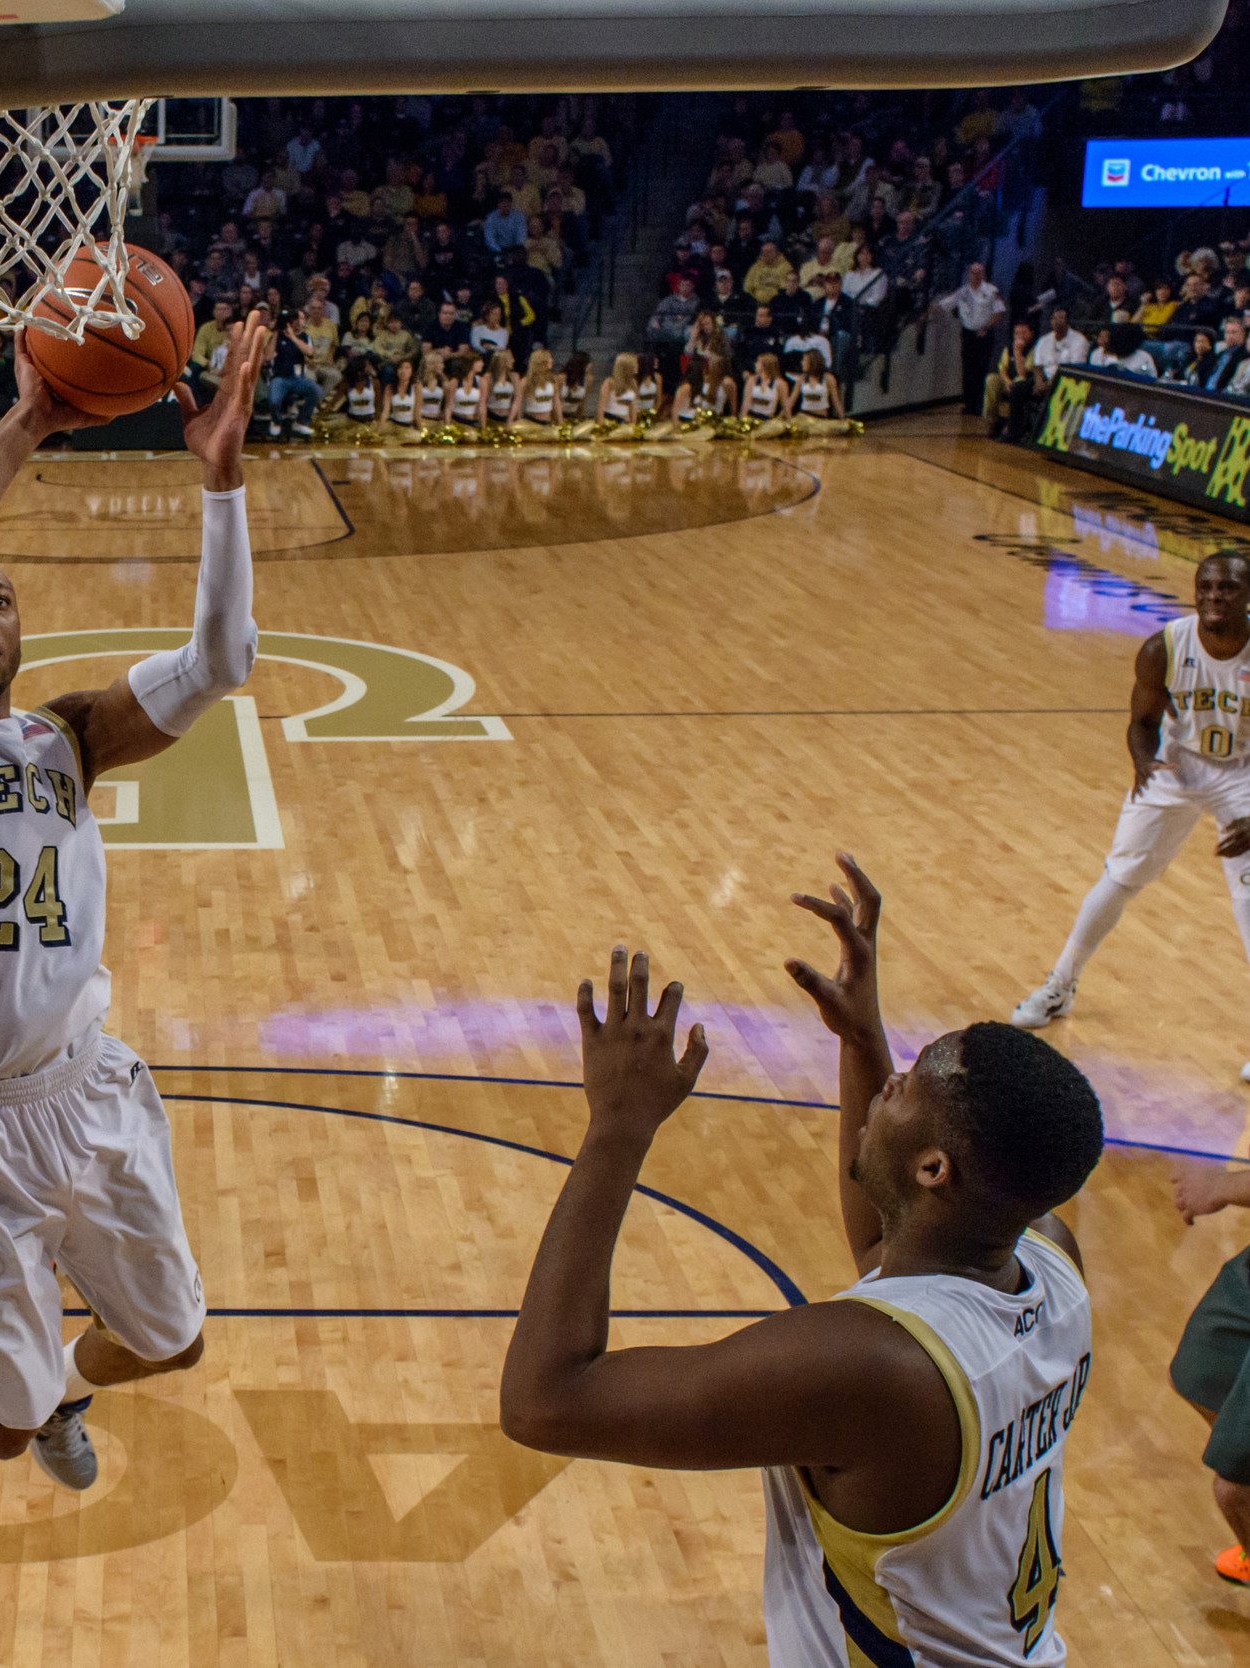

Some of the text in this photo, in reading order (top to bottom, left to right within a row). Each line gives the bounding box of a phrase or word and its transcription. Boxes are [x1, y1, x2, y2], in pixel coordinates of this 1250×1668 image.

[1141, 164, 1221, 182] Chevron
[1200, 724, 1234, 758] 0
[979, 1379, 1069, 1501] CARTER
[1007, 1466, 1063, 1660] 4
